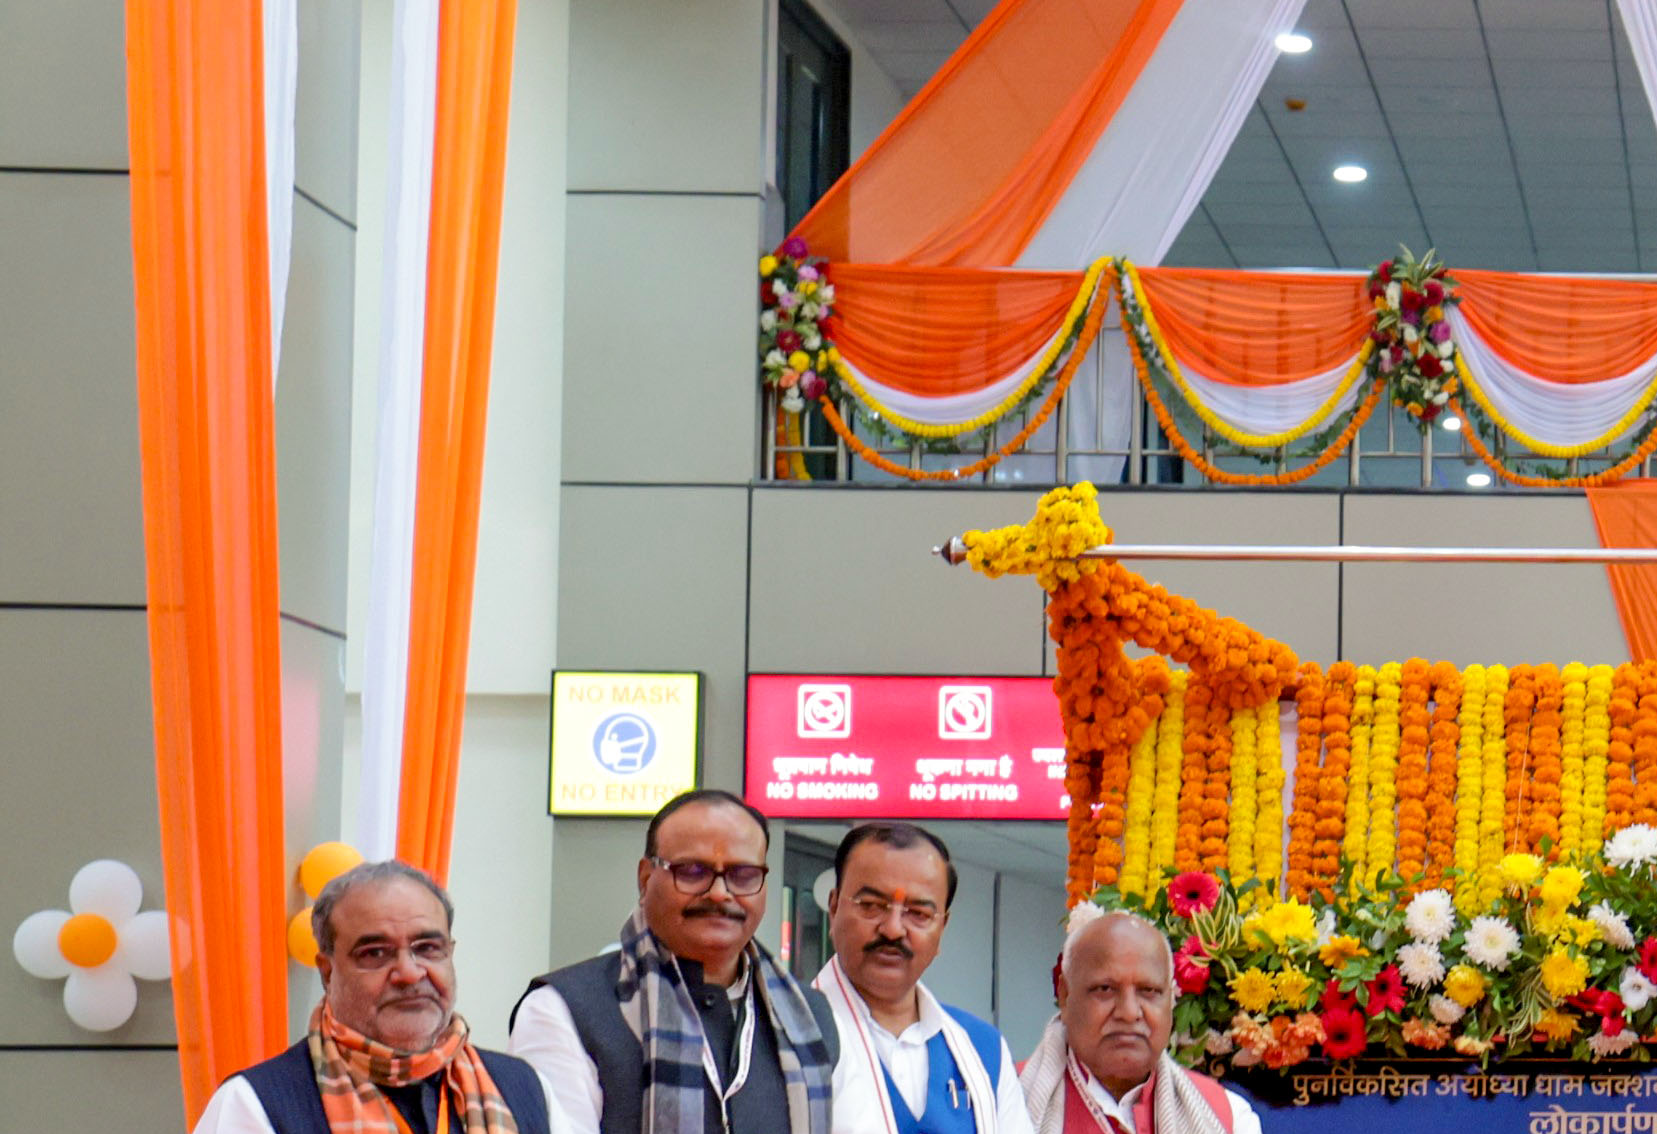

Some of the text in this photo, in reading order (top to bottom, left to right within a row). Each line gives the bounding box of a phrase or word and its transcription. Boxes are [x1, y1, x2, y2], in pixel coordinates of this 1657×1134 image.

[568, 684, 681, 704] NO MASK
[561, 783, 596, 801] NO
[766, 782, 879, 800] NO SMOKING
[909, 783, 1019, 801] NO SPITTING
[1534, 1075, 1585, 1098] धाम
